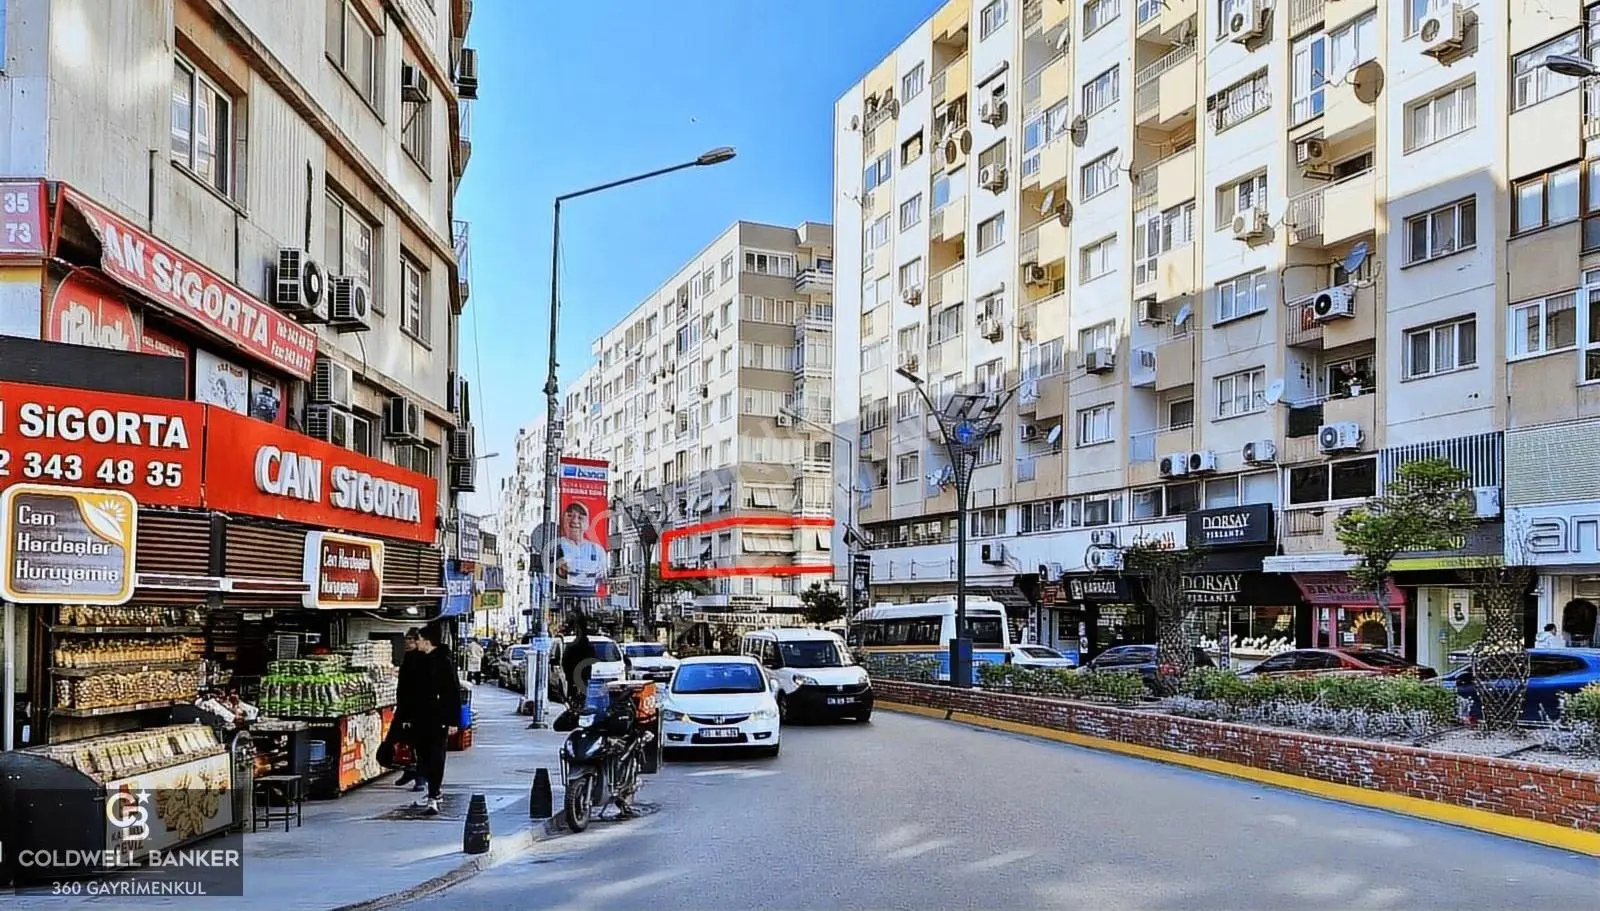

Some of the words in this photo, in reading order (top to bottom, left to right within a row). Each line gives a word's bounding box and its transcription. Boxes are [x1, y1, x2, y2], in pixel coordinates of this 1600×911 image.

[4, 192, 29, 213] 35
[5, 222, 31, 243] 73
[19, 402, 189, 450] SiGORTA
[23, 451, 83, 480] 343
[96, 458, 134, 485] 48
[146, 460, 182, 488] 35
[254, 445, 322, 504] CAN
[18, 503, 56, 527] Can
[1202, 513, 1252, 531] DORSAY
[1181, 574, 1243, 592] DORSAY
